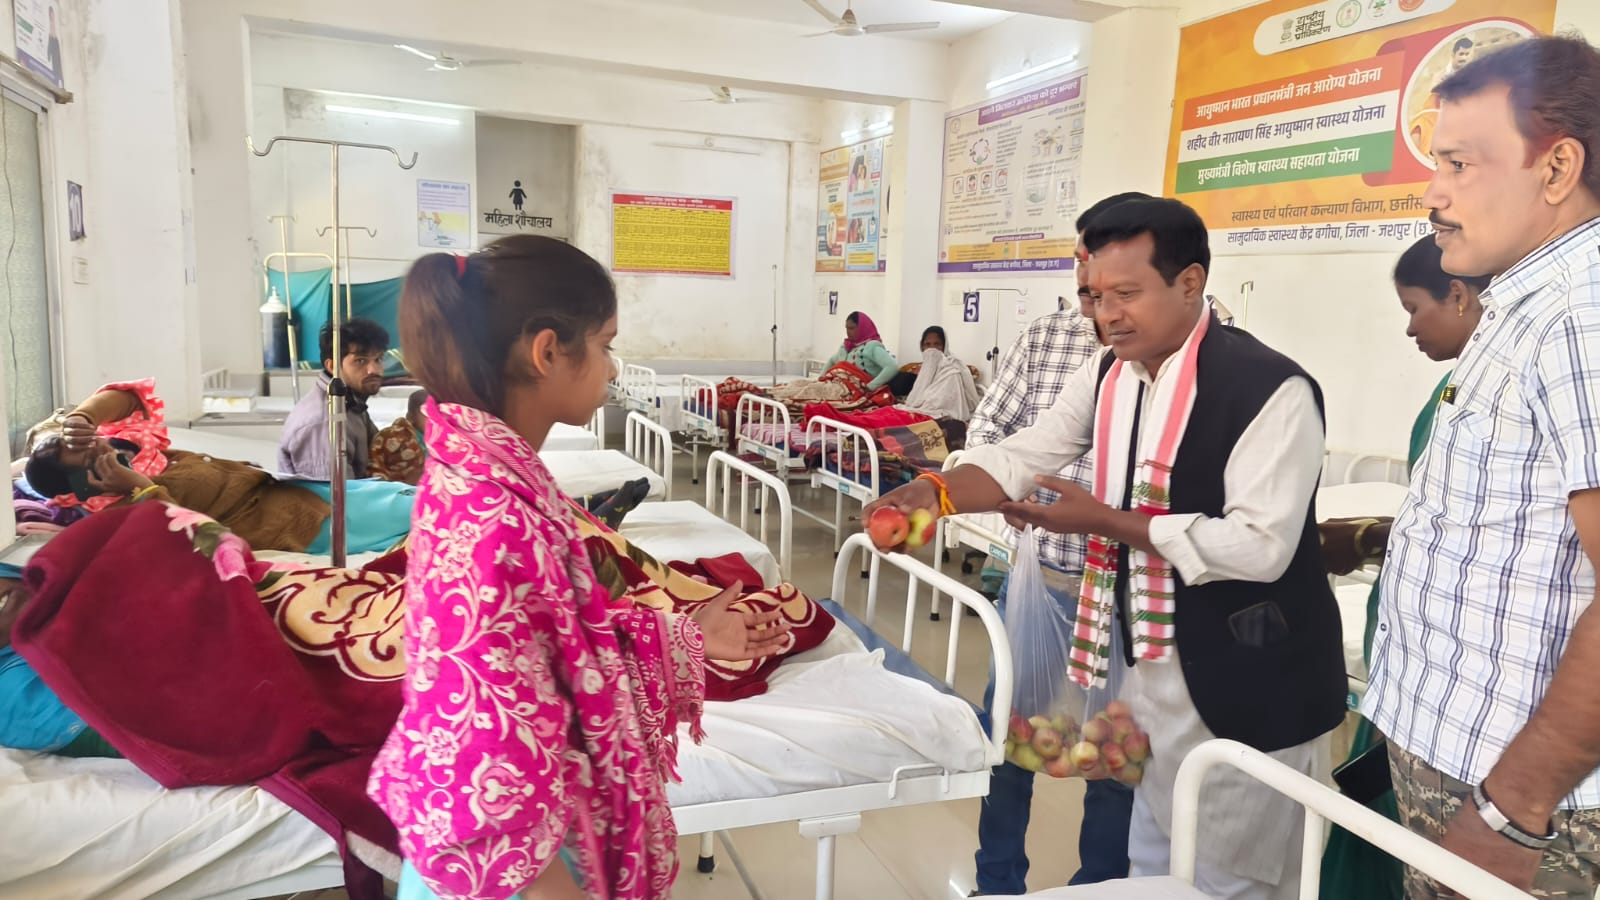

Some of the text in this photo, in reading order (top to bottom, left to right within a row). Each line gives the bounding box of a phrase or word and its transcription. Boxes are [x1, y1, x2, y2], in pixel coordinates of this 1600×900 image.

[1296, 10, 1325, 24] राष्ट्रीय
[1196, 67, 1382, 120] आयुष्मान भारत प्रधानमंत्री जन आरोग्य योजना
[1187, 105, 1386, 151] शहीद वीर नारायण सिंह आयुष्मान स्वास्थ्य योजना
[1198, 146, 1360, 184] मुख्यमंत्री विशेष स्वास्थ्य सहायता योजना
[70, 192, 81, 233] 10
[484, 208, 552, 230] महिला शौचालय
[1231, 194, 1424, 222] स्वास्थ्य एवं परिवार कल्याण विभाग, छत्तीस
[1227, 228, 1267, 246] सामुदायिक
[1268, 228, 1298, 242] स्वास्थ्य
[1299, 225, 1314, 240] केंद्र
[1315, 224, 1342, 240] बगीचा,
[1345, 223, 1370, 239] जिला
[1378, 223, 1412, 240] जशपुर
[830, 295, 837, 313] 7
[966, 297, 977, 320] 5
